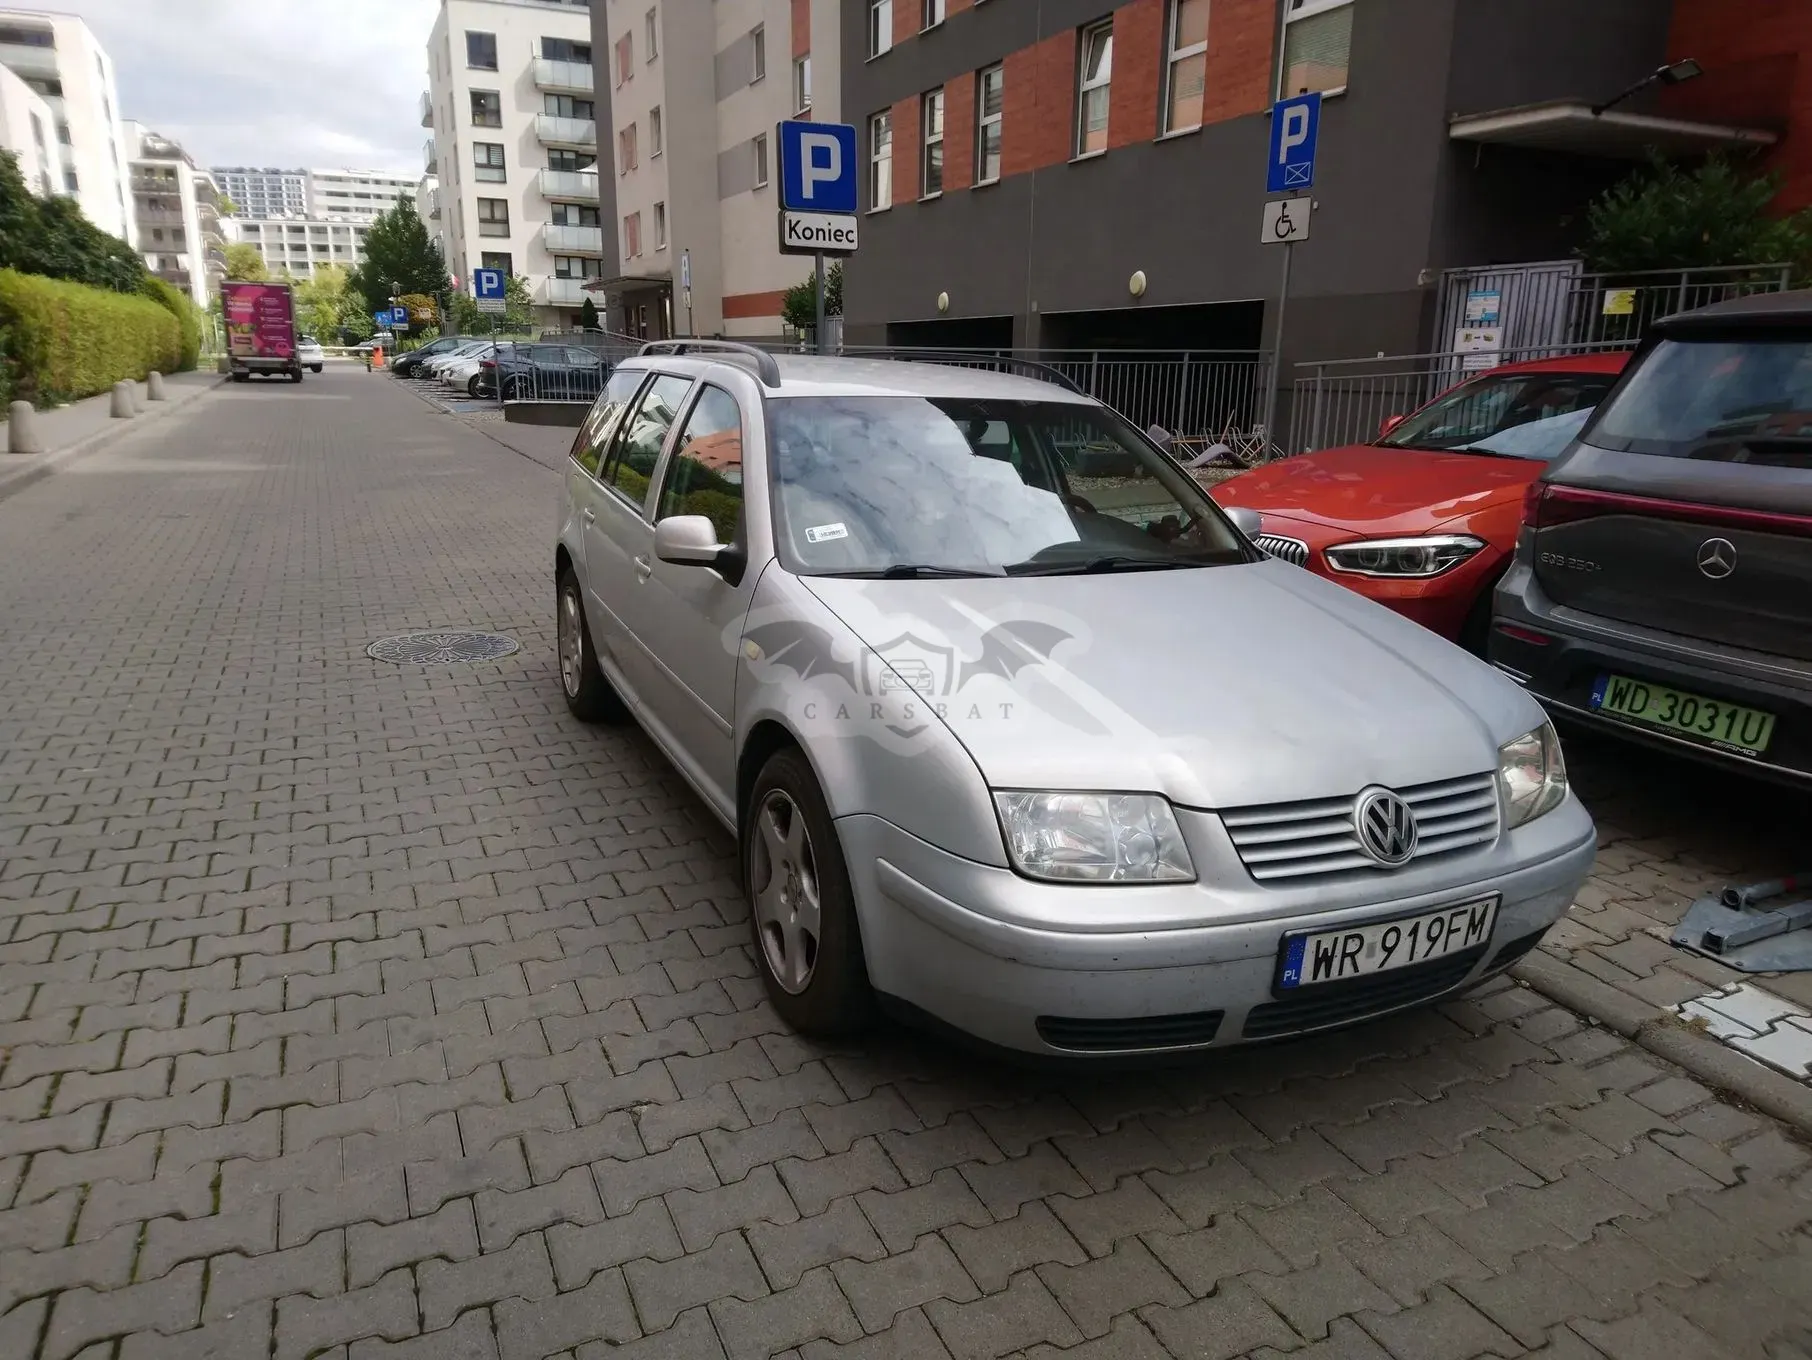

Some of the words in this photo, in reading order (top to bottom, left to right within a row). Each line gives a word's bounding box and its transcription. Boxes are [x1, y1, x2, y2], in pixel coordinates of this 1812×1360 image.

[1279, 104, 1309, 164] P
[800, 132, 841, 199] P
[788, 219, 855, 243] Koniec
[481, 271, 499, 294] P
[394, 308, 405, 320] P
[1591, 692, 1602, 702] PL
[1609, 679, 1651, 715] WD
[1658, 693, 1767, 745] 3031U
[1725, 742, 1758, 757] AMG
[1312, 933, 1365, 981] WR
[1378, 903, 1490, 970] 919FM
[1283, 969, 1298, 981] PL
